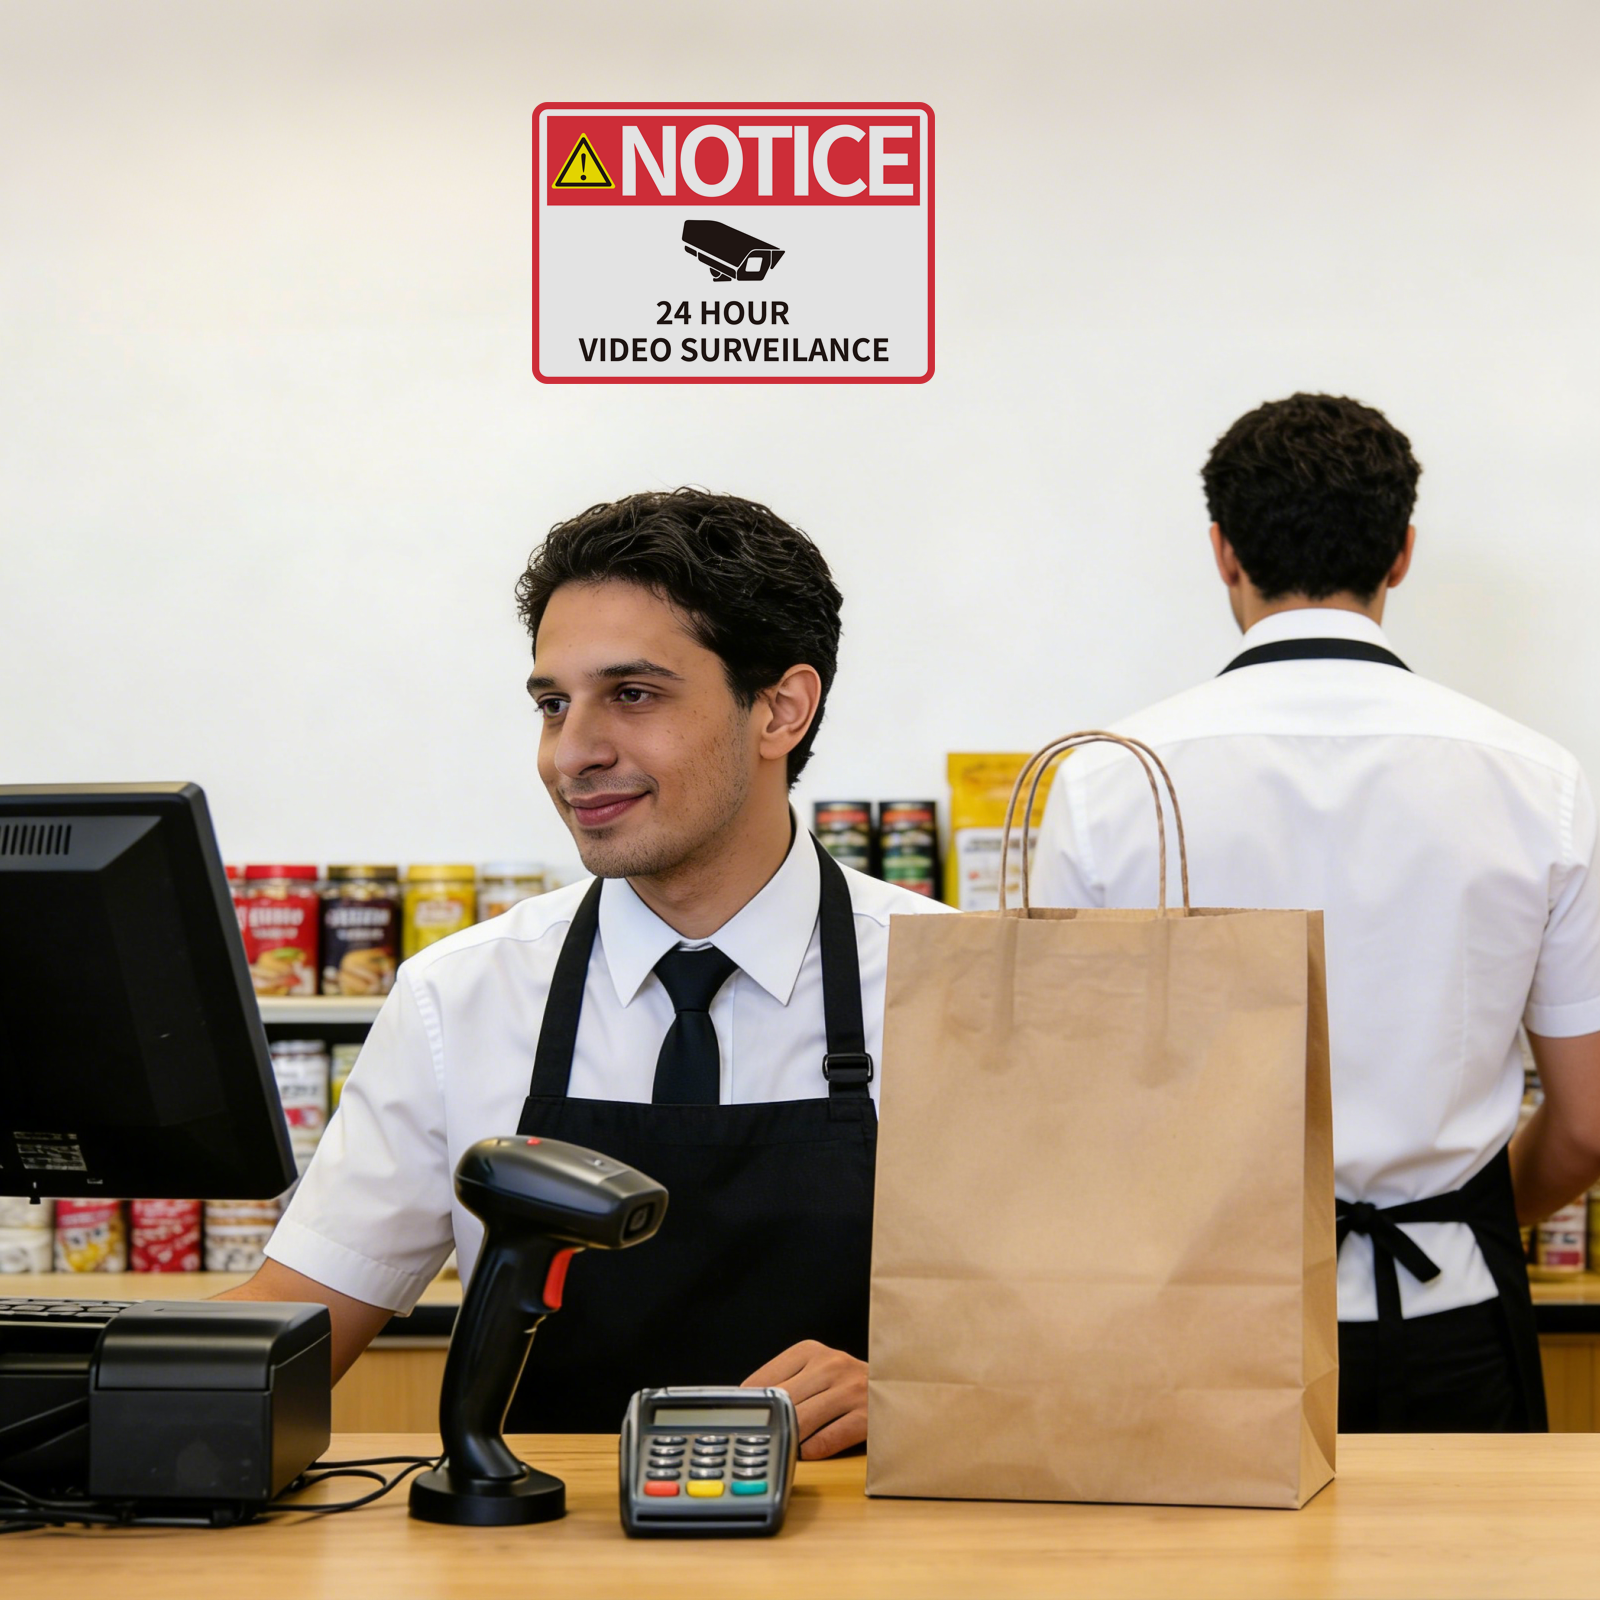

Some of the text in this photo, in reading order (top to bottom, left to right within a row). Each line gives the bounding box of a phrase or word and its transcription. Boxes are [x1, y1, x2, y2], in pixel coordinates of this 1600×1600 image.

[622, 124, 914, 198] NOTICE
[656, 300, 790, 325] 24 HOUR
[579, 337, 889, 362] VIDEO SURVEILANCE
